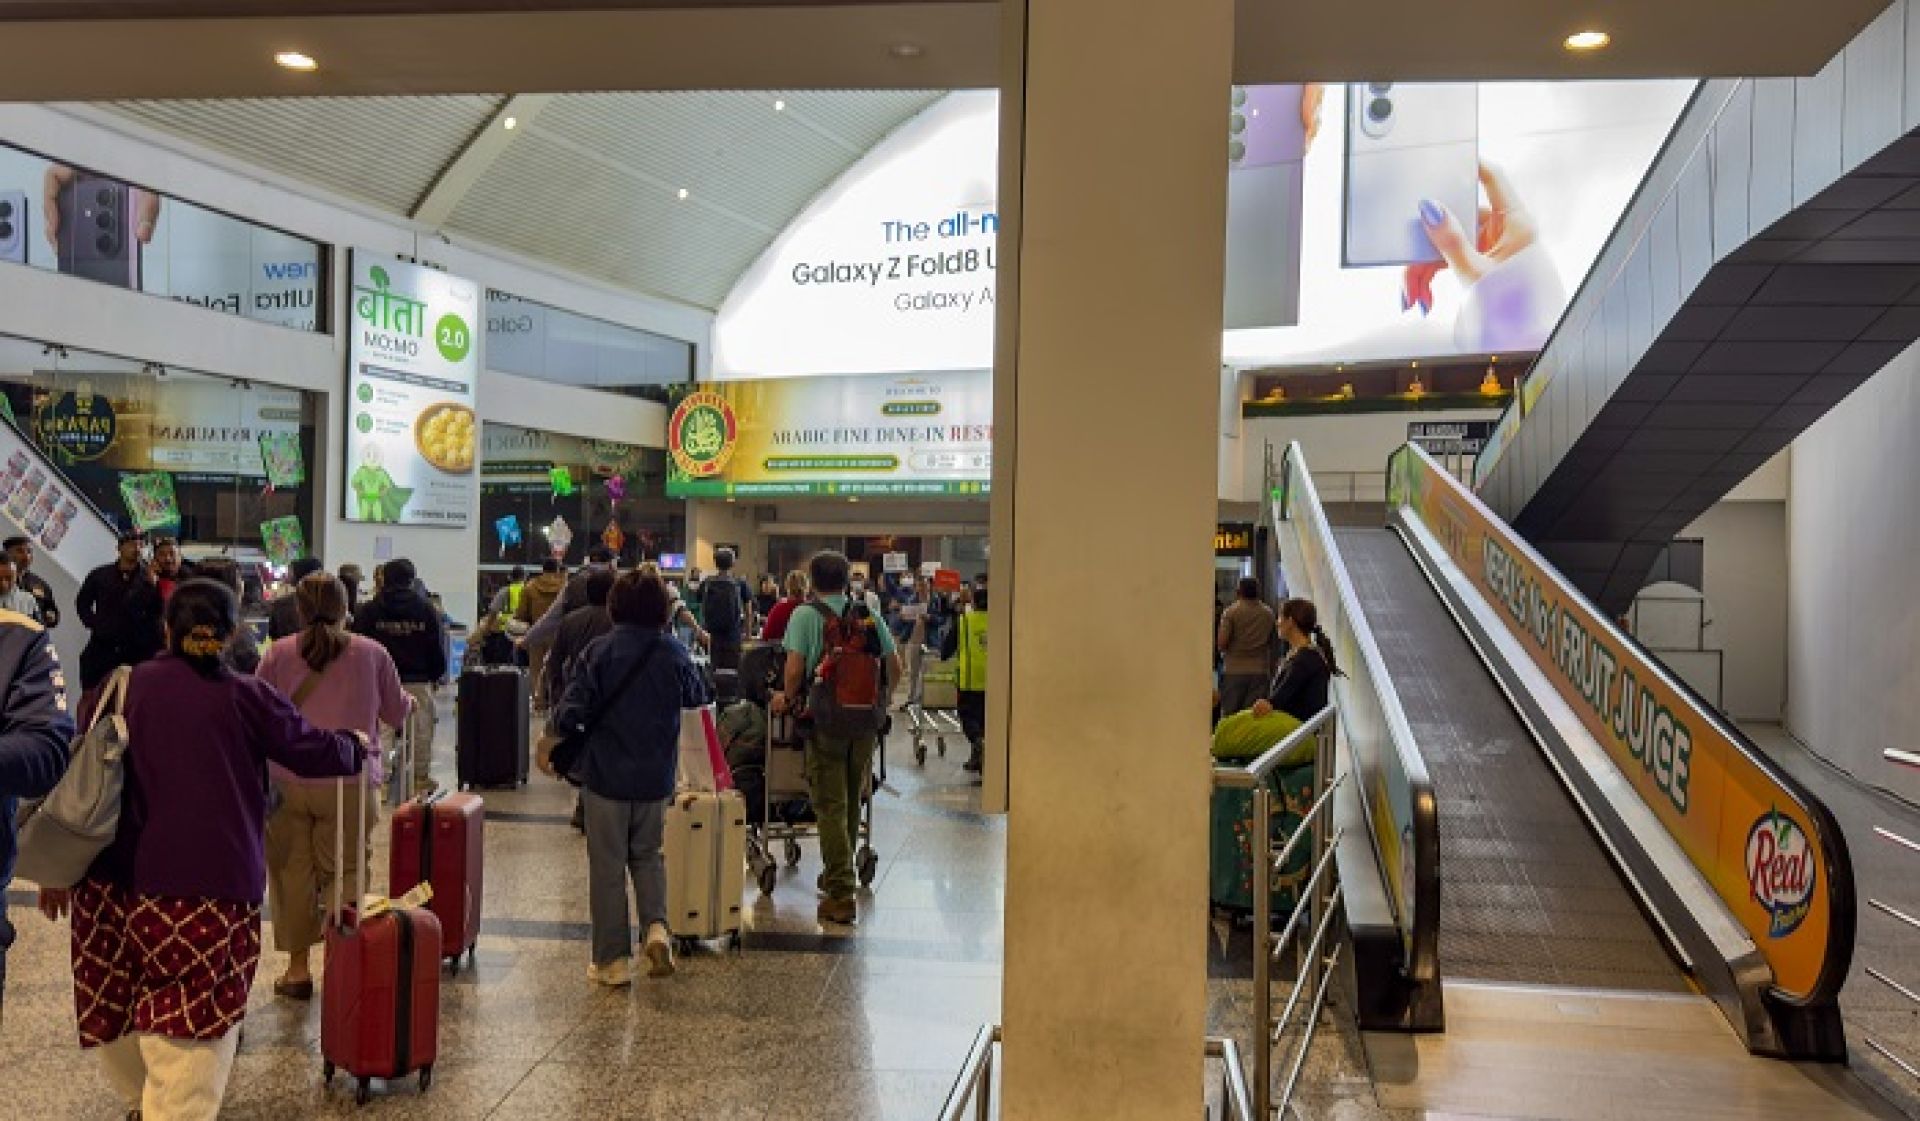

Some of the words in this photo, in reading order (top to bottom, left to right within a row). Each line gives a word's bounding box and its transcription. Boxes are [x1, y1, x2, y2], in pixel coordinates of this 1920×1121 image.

[882, 221, 931, 243] The
[792, 260, 883, 286] Galaxy
[886, 257, 901, 280] Z
[907, 248, 981, 277] Fold8
[894, 291, 974, 312] Galaxy
[441, 328, 464, 350] 2.0
[771, 428, 830, 446] ARABIC
[834, 427, 873, 444] FINE
[877, 424, 946, 443] DINE-IN
[1558, 608, 1617, 723] FRUIT
[1612, 668, 1693, 815] JUICE
[1749, 829, 1812, 903] Real
